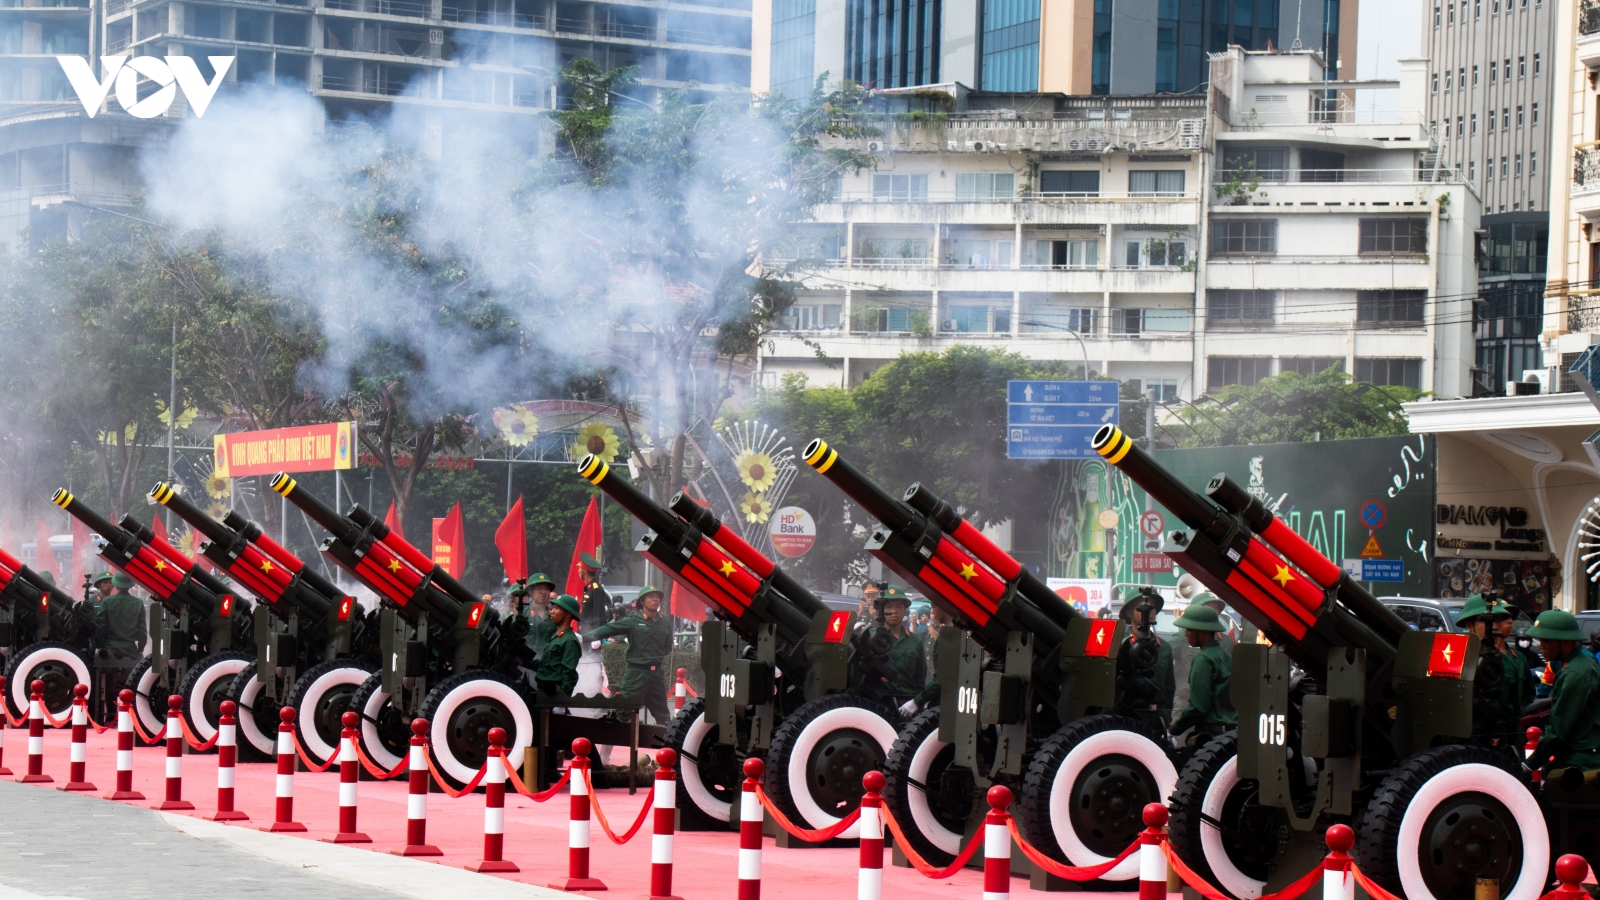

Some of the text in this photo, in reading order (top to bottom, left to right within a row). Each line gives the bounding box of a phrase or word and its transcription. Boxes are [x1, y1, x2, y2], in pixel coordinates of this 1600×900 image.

[231, 442, 247, 467] VINH
[247, 440, 268, 468] QUANG
[268, 434, 285, 464] PHÁO
[285, 437, 301, 462] BINH
[301, 430, 316, 466] VIỆT
[316, 434, 331, 460] NAM
[780, 523, 805, 534] Bank
[781, 514, 795, 524] HD
[1134, 555, 1143, 569] CHÚ
[1145, 555, 1149, 569] Ý
[1149, 557, 1162, 569] QUAN
[1089, 589, 1102, 601] 30.4
[720, 673, 735, 698] 013
[958, 686, 978, 715] 014
[1258, 713, 1285, 747] 015
